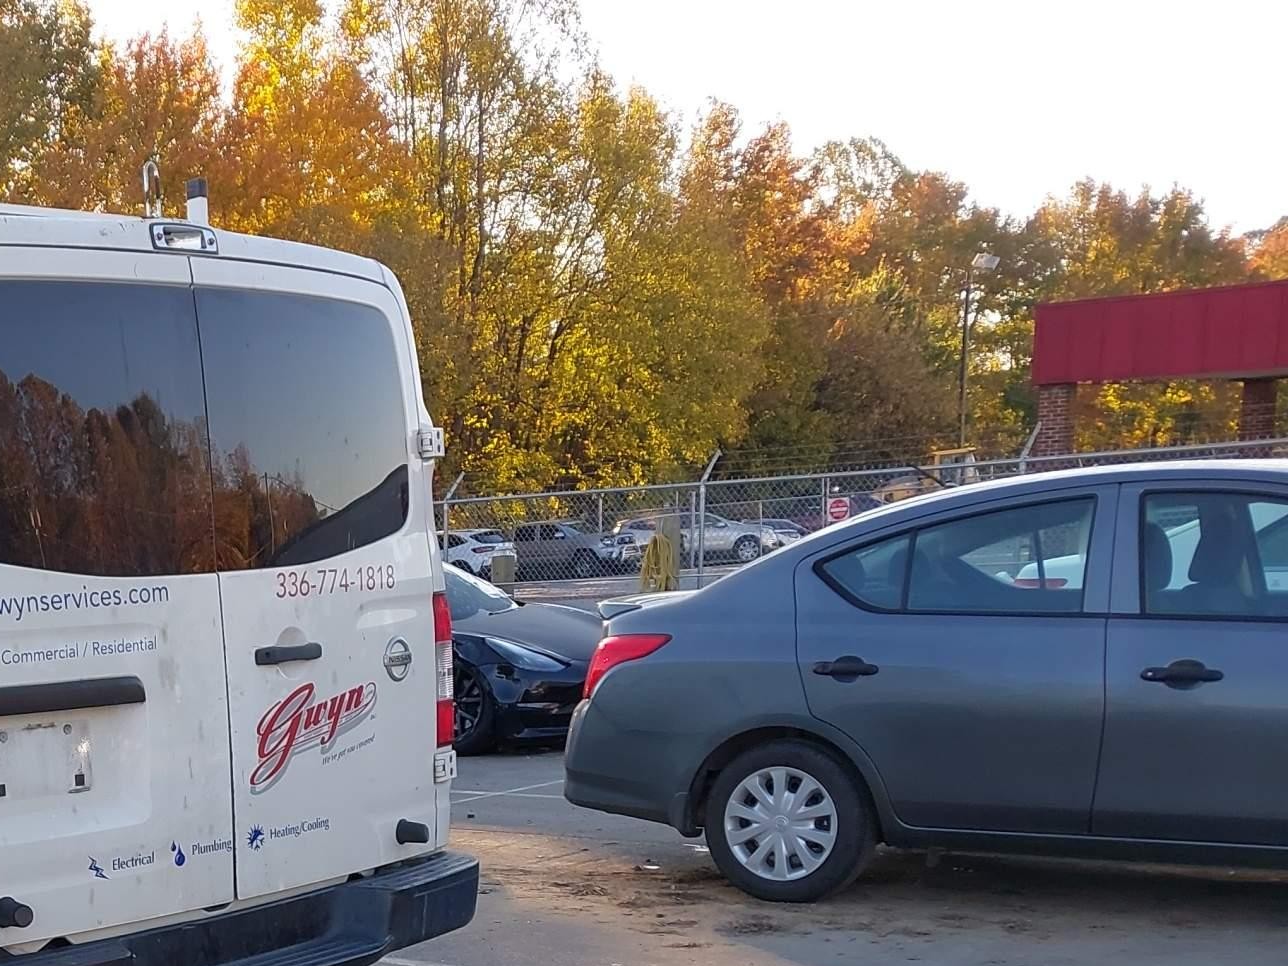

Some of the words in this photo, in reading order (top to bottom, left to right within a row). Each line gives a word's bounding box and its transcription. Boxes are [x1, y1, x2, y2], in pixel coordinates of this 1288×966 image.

[276, 565, 395, 598] 336-774-1818
[1, 642, 79, 665] Commercial
[92, 635, 158, 656] Residential
[250, 681, 376, 791] Gwyn
[269, 818, 330, 839] Heating/Cooling
[191, 839, 232, 856] Plumbing
[112, 852, 155, 871] Electrical
